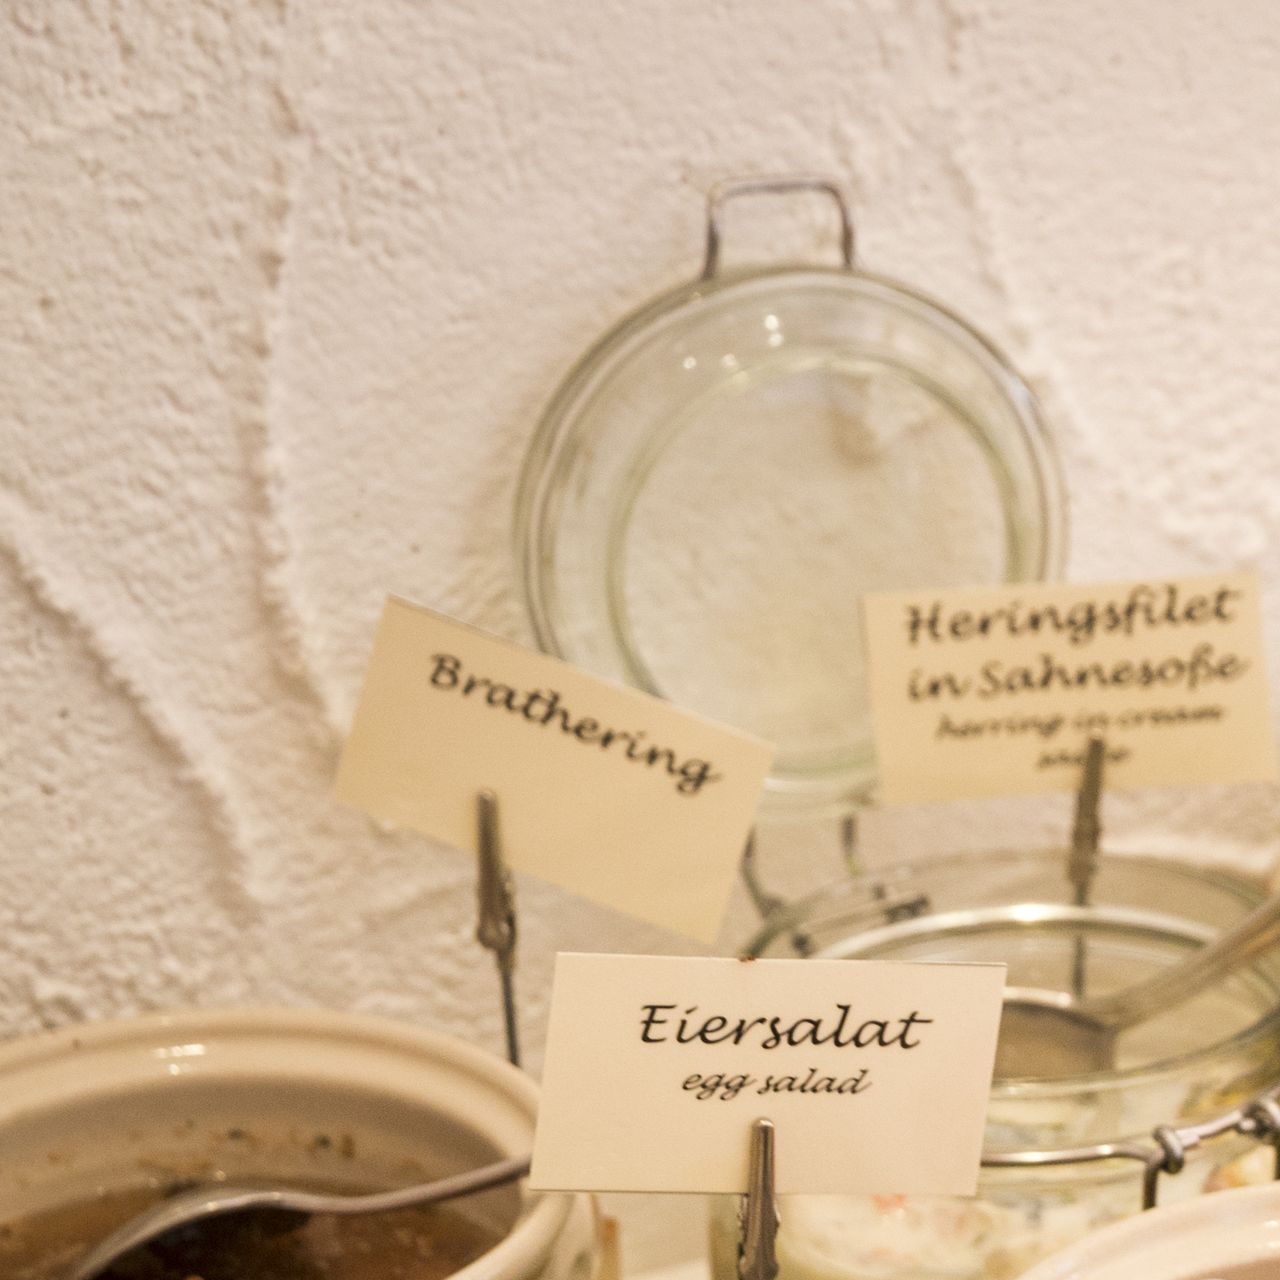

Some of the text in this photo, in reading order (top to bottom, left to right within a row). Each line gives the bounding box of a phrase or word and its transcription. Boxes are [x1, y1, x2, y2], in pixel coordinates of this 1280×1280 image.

[906, 584, 1240, 646] Heringsfilet
[907, 668, 967, 701] in
[428, 652, 723, 796] Brathering
[638, 1002, 934, 1051] Eiersalat
[682, 1067, 872, 1101] egg salad
